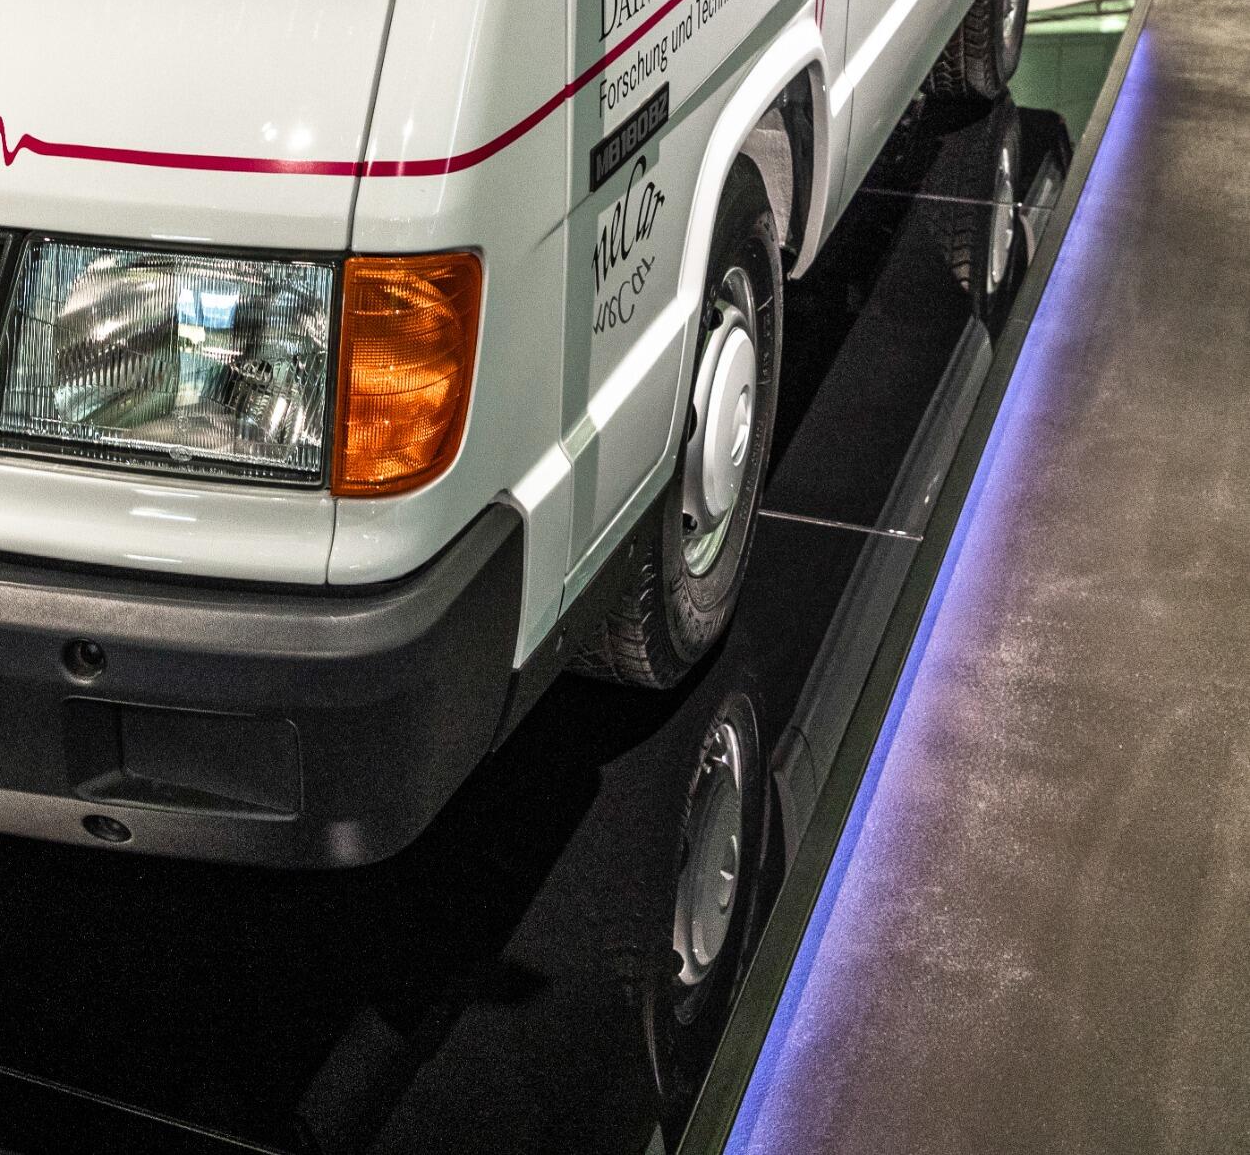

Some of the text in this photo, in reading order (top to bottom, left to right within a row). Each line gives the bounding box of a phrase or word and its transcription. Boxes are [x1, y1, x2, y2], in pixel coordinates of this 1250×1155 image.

[599, 35, 668, 119] Forschung
[671, 15, 693, 54] und
[591, 154, 666, 296] neCar
